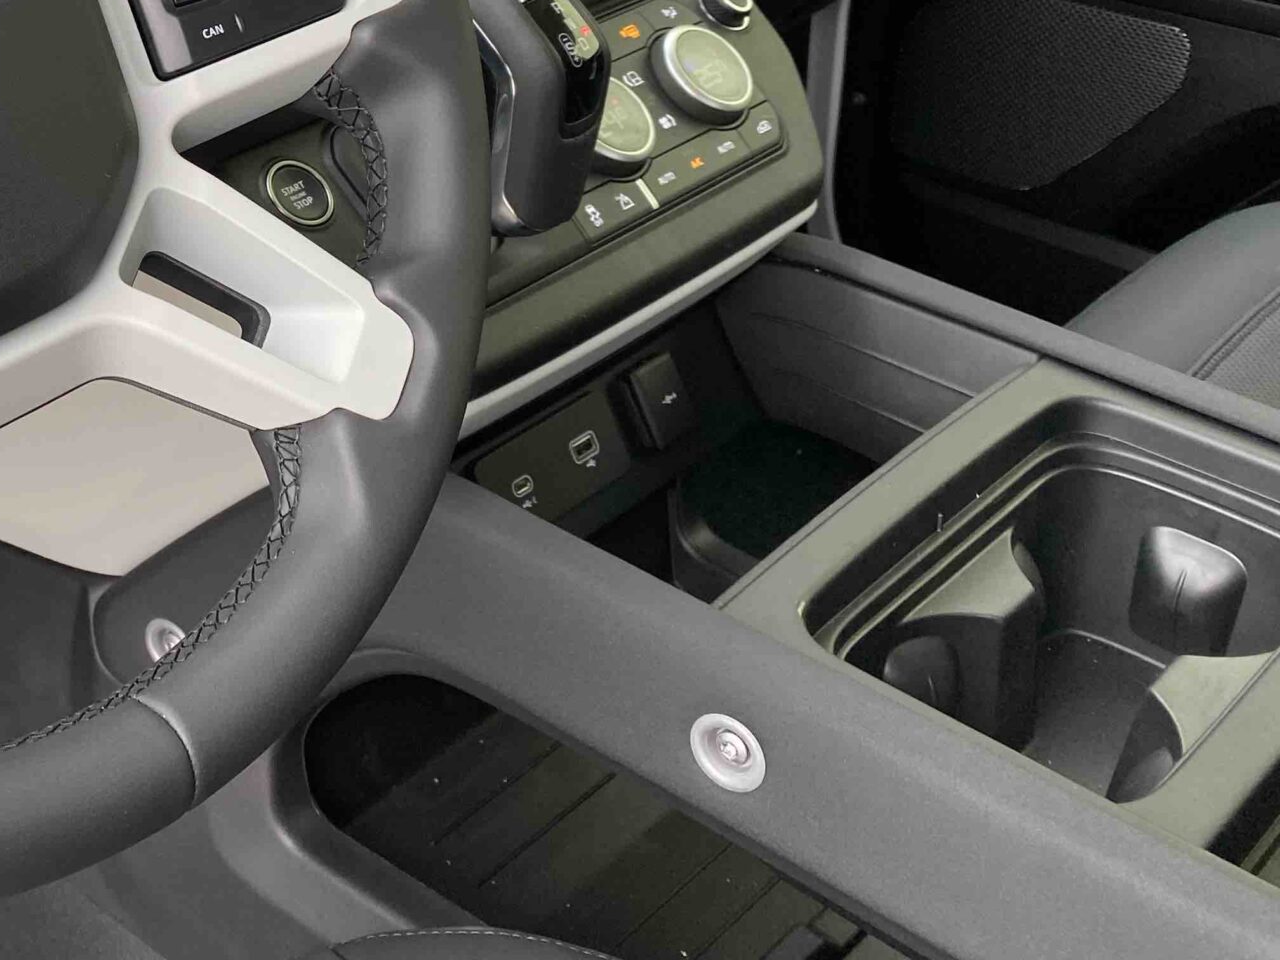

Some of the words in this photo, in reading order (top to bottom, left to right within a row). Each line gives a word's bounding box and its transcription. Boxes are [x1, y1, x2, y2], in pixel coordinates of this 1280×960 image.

[202, 23, 225, 39] CAN
[281, 181, 305, 196] START
[293, 196, 313, 210] STOP
